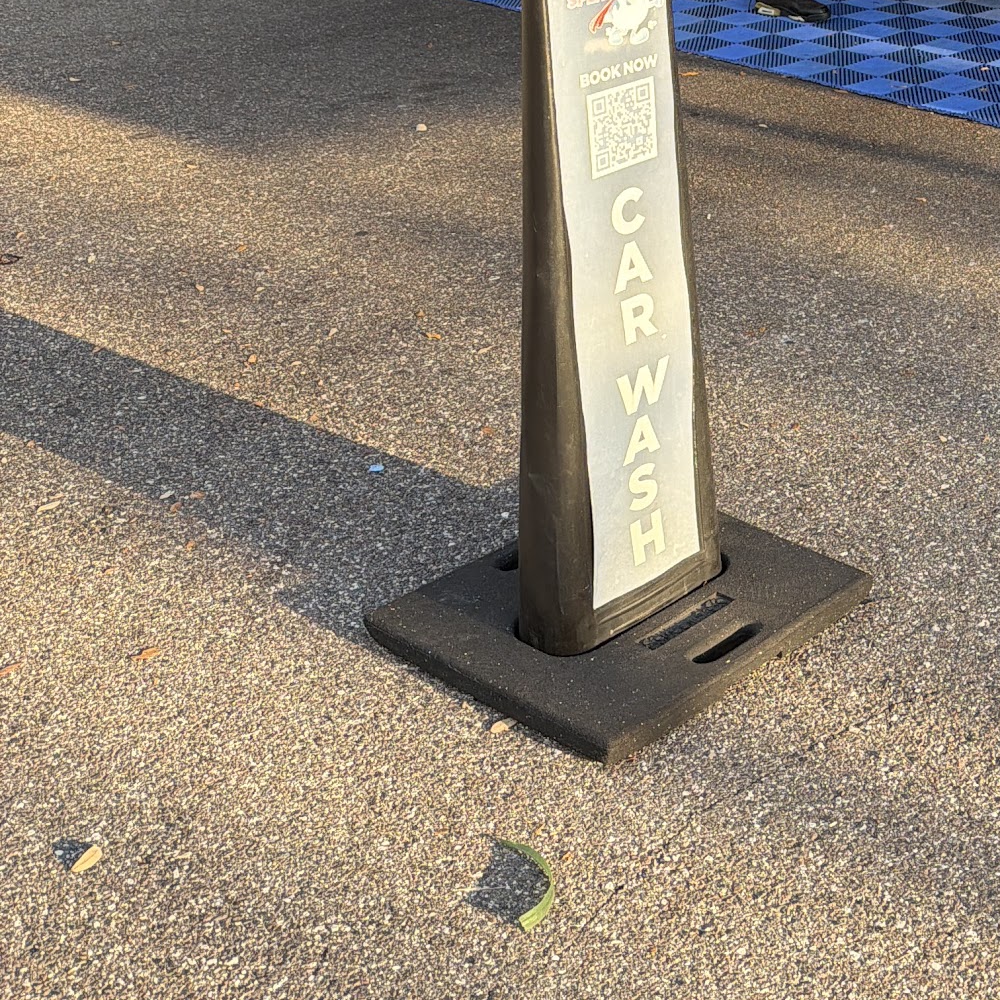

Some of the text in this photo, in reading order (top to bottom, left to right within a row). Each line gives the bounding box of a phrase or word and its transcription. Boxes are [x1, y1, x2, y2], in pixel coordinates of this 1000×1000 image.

[579, 53, 659, 89] BOOK NOW
[611, 186, 660, 346] CAR
[616, 354, 670, 567] WASH
